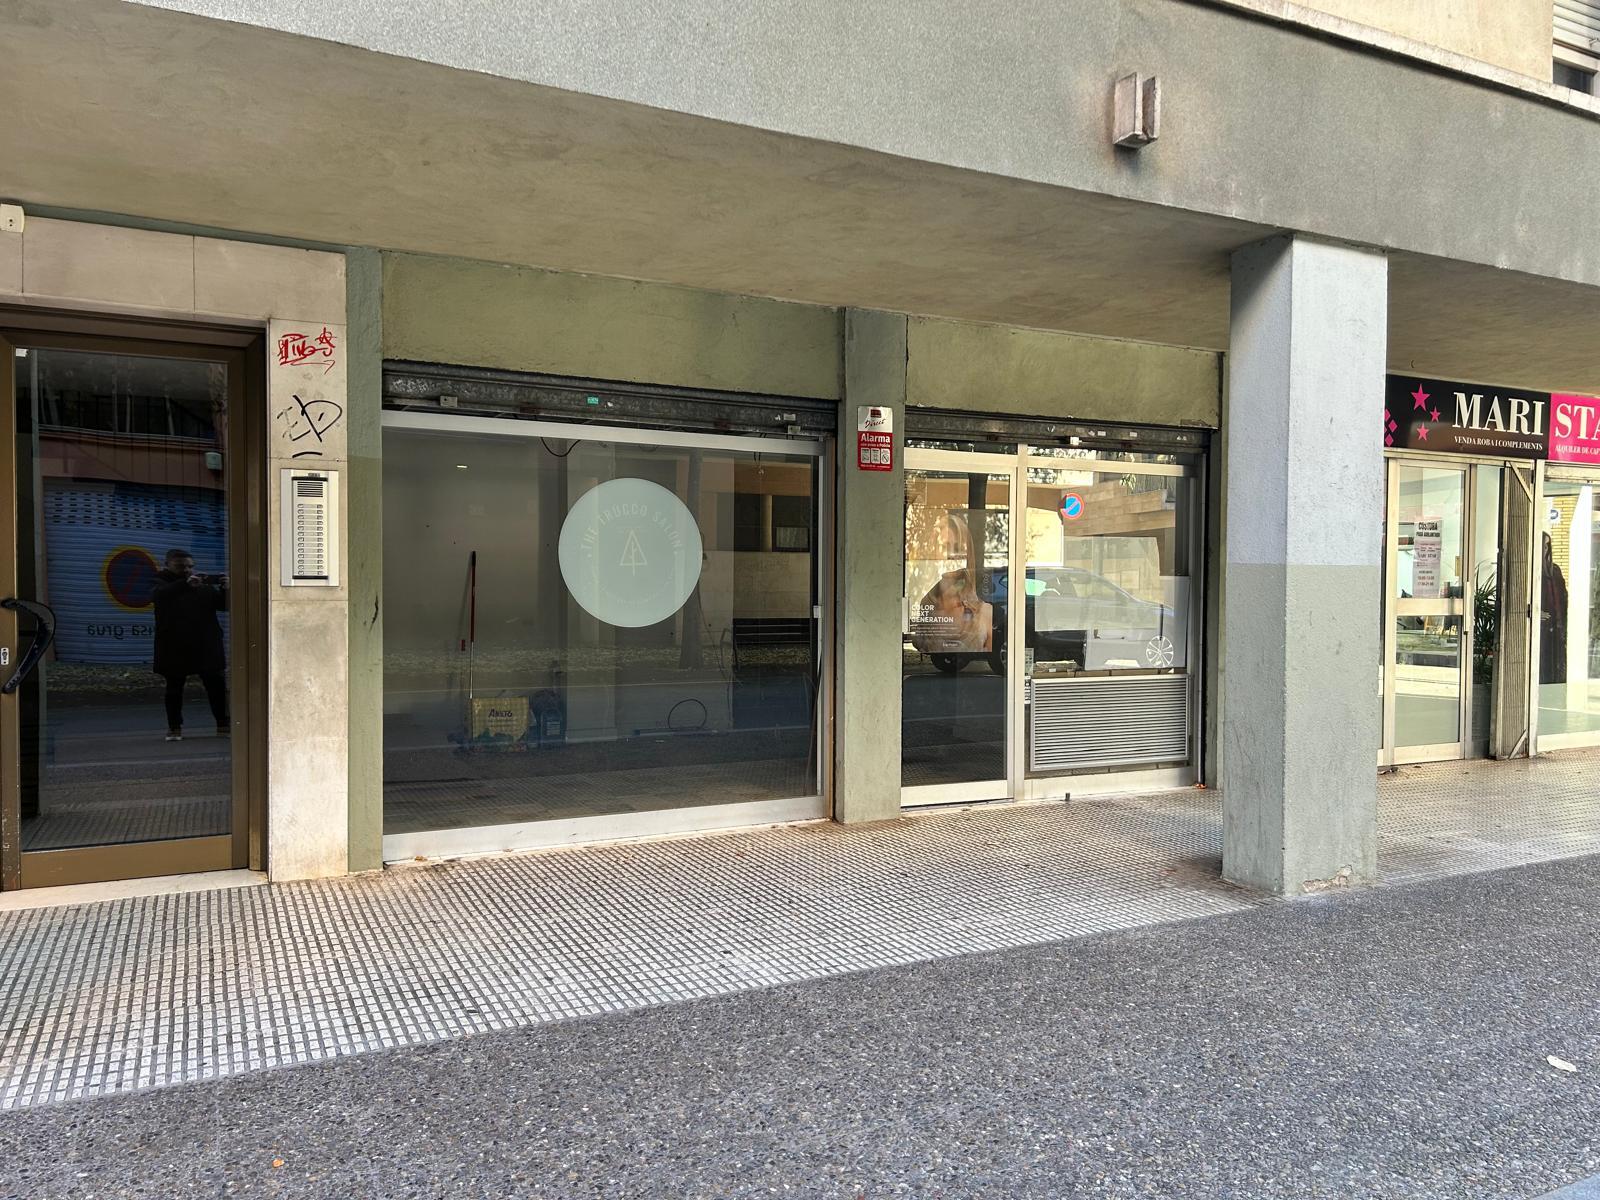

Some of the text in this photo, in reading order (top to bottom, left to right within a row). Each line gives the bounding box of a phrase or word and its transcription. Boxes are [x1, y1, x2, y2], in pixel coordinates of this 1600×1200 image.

[1451, 391, 1545, 436] MARI
[860, 433, 890, 443] Alarma
[1454, 435, 1476, 445] VENDA
[1476, 438, 1494, 446] ROBA
[1498, 439, 1543, 451] COMPLEMENTS
[1554, 444, 1581, 454] ALQUILER
[580, 524, 599, 550] THE
[652, 511, 684, 549] SALON
